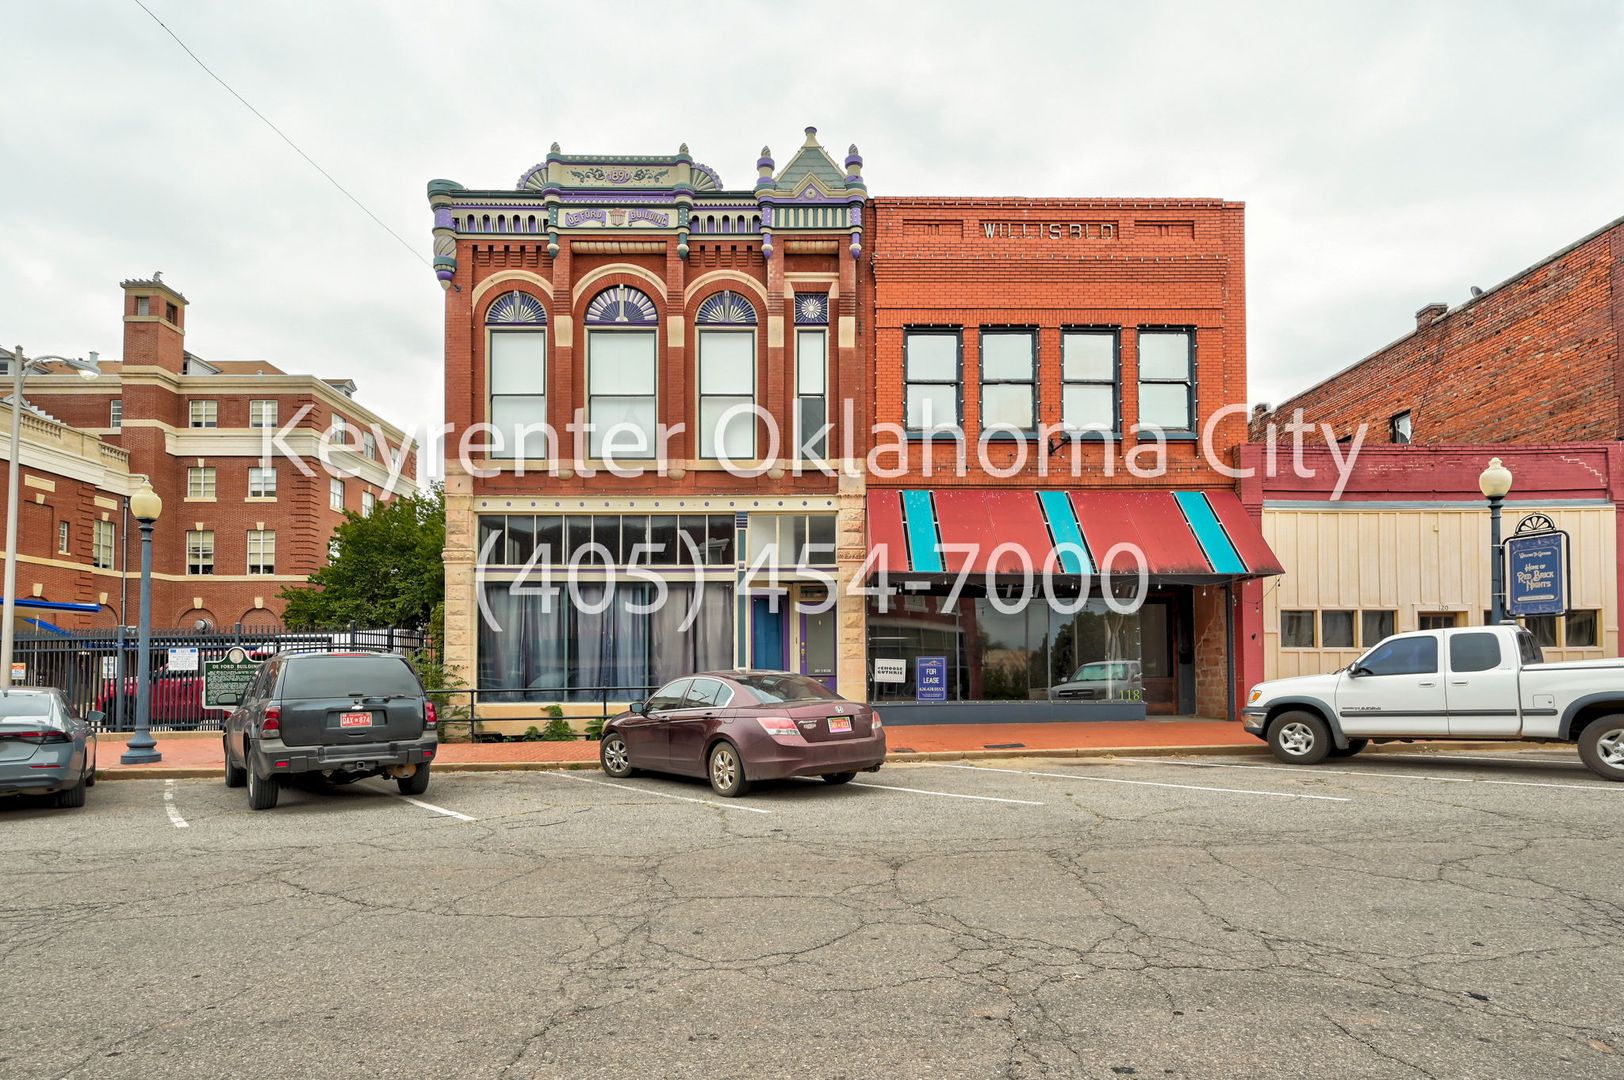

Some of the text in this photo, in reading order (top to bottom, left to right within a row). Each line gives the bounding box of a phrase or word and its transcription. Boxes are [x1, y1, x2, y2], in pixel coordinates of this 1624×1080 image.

[608, 170, 630, 180] 1890
[568, 210, 666, 226] DE FORD BUILDING
[1119, 689, 1140, 701] 118
